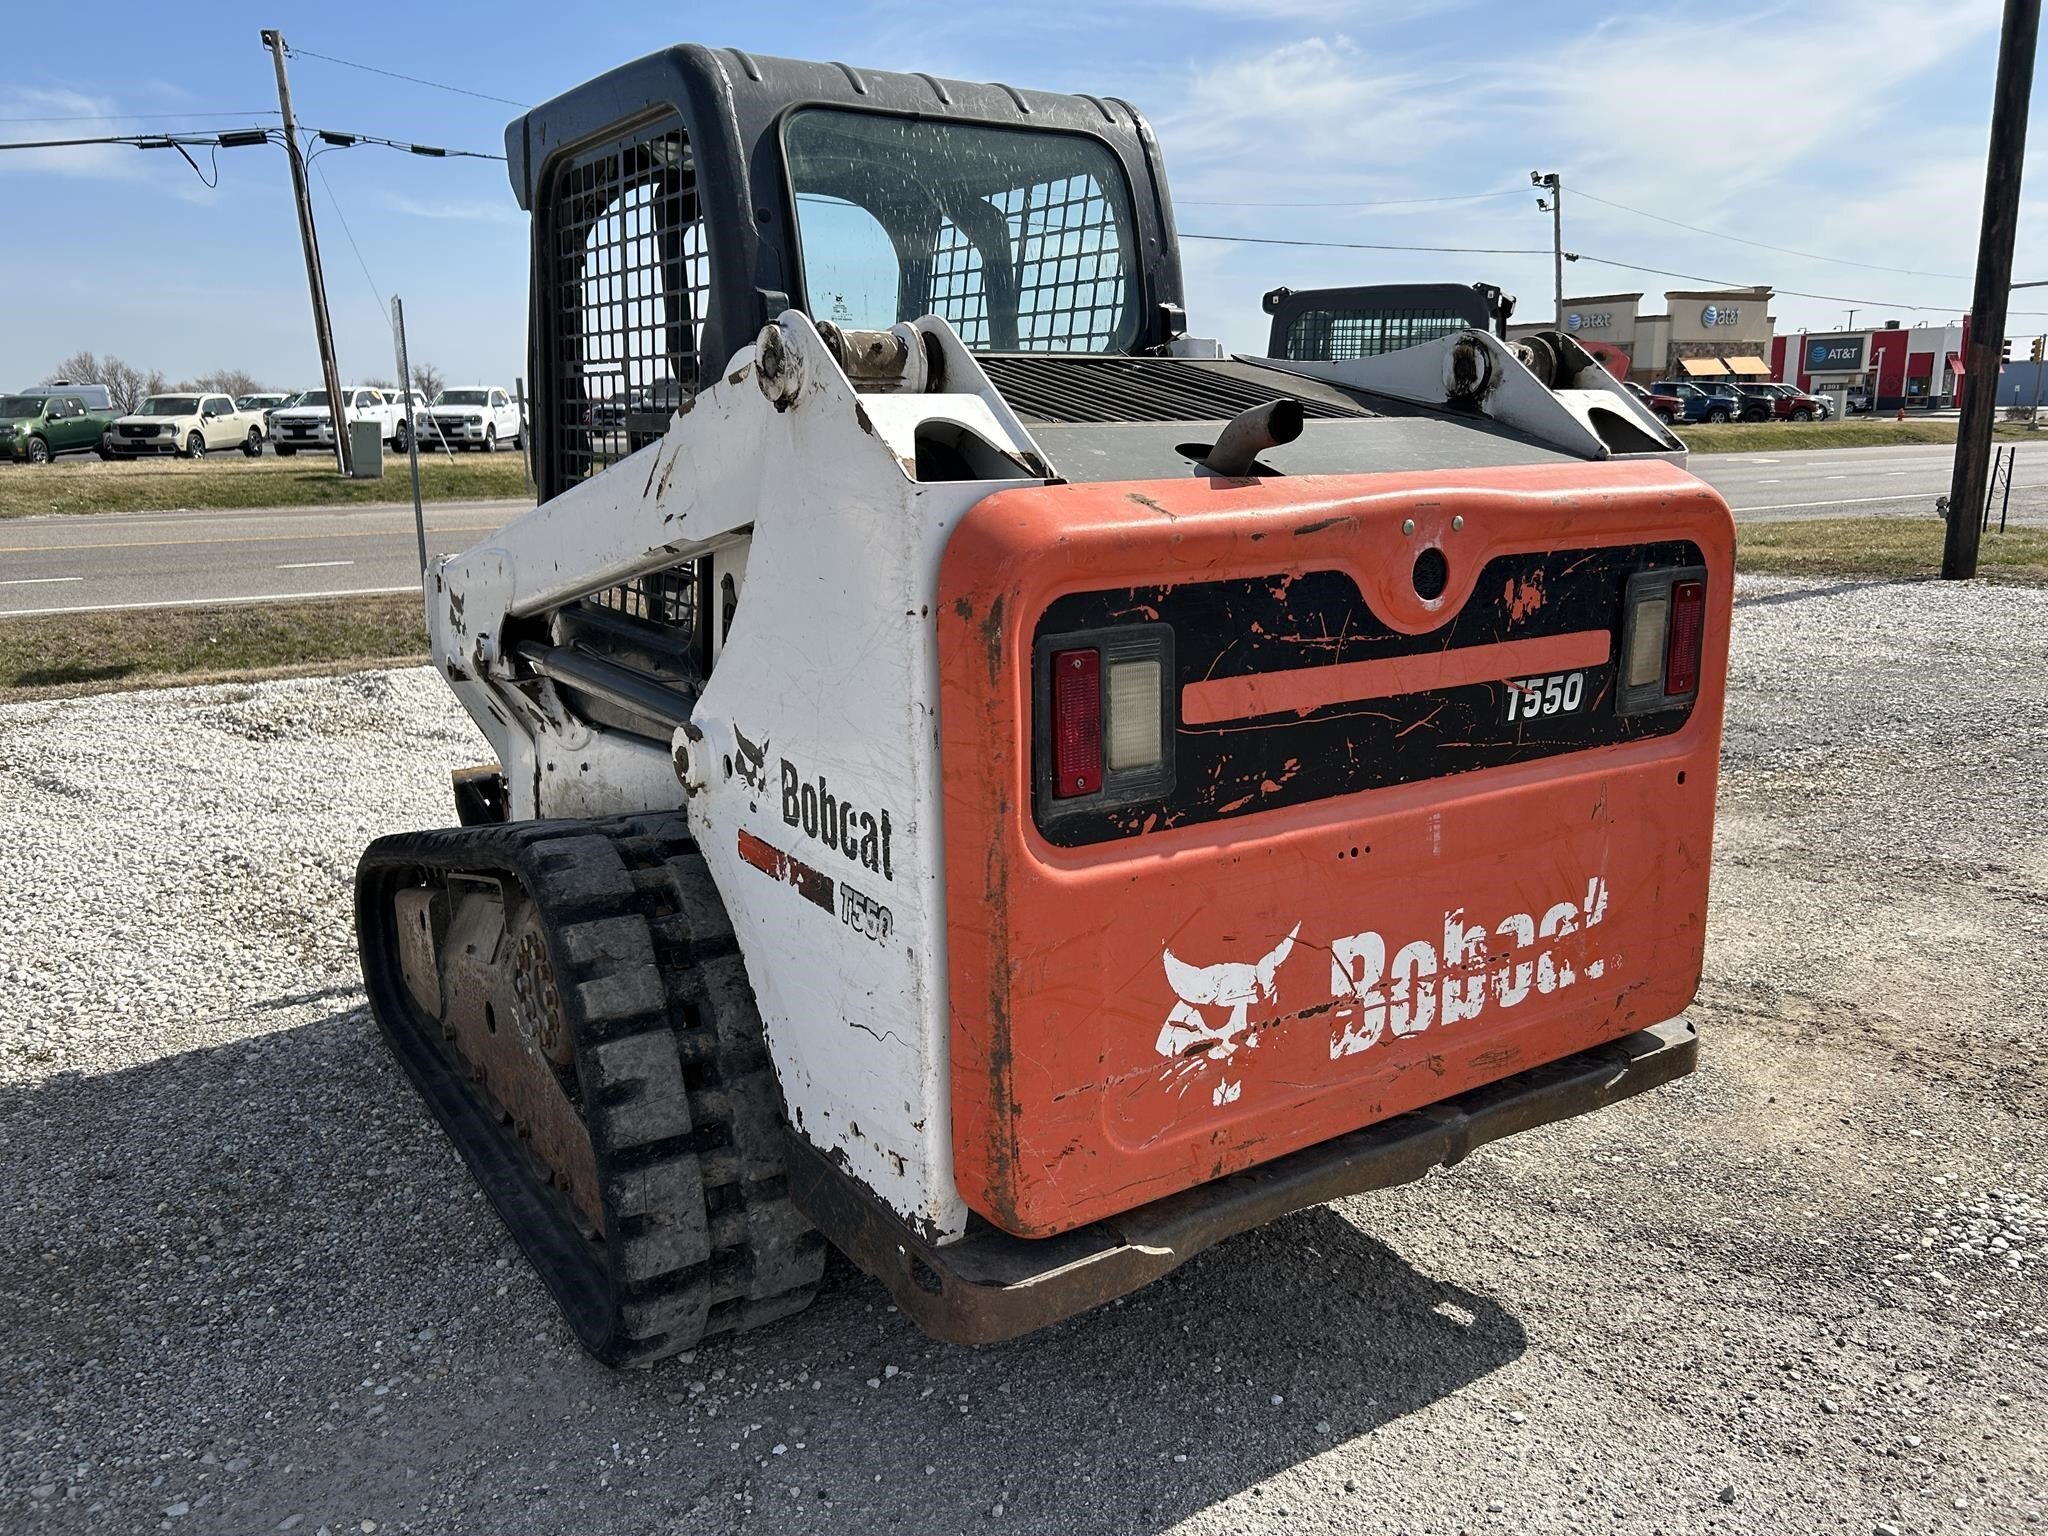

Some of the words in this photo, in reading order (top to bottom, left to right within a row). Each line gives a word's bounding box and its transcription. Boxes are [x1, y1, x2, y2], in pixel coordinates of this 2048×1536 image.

[1582, 313, 1611, 329] at&t
[1717, 306, 1742, 326] at&t
[1828, 347, 1858, 360] AT&T
[1507, 672, 1584, 721] T550
[780, 757, 893, 882] Bobcat
[840, 881, 893, 947] T550
